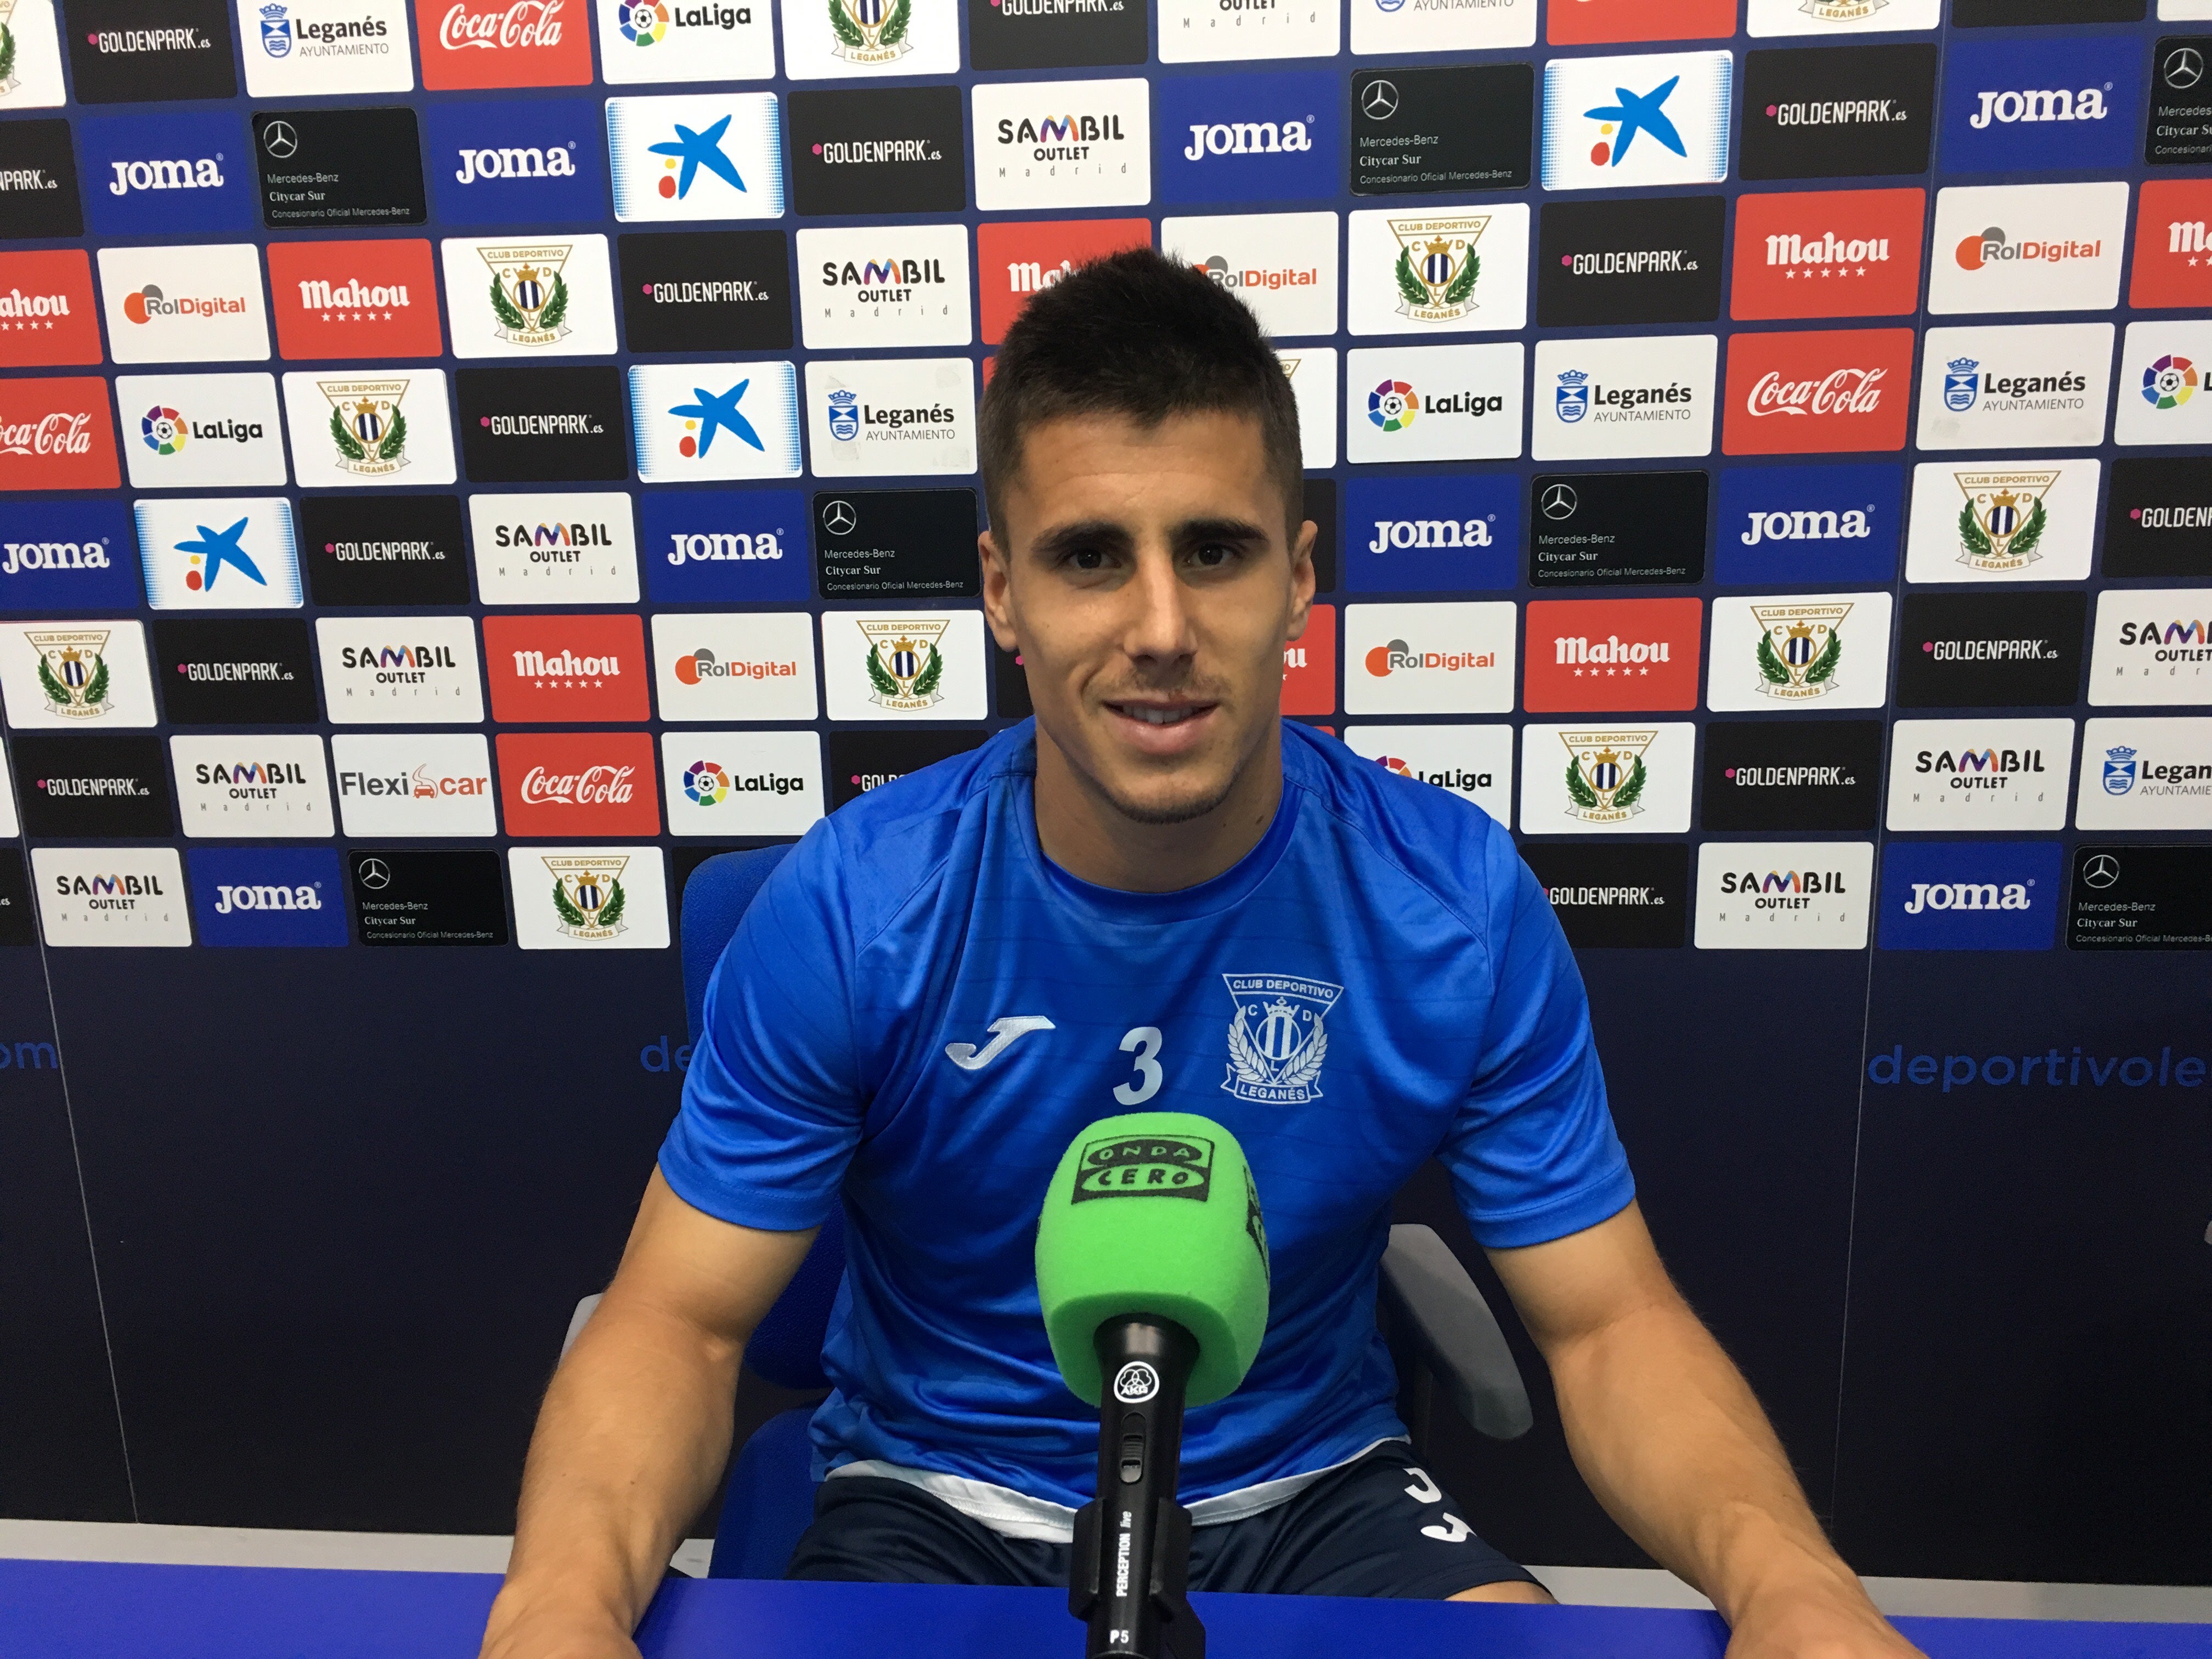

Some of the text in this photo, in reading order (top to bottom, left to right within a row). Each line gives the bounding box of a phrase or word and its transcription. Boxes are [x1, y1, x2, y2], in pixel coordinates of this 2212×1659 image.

[675, 3, 751, 30] LaLiga
[1819, 5, 1869, 18] LEGANÉS
[440, 0, 564, 49] Coca-Cola
[1184, 12, 1315, 27] Madrid
[296, 16, 387, 43] Leganés
[99, 29, 211, 53] GOLDENPARK.es
[300, 43, 388, 57] AYUNTAMIENTO
[851, 50, 895, 61] LEGANÉS
[1778, 100, 1906, 125] GOLDENPARK.es
[998, 115, 1124, 144] SAMBIL
[2157, 126, 2199, 138] Citycar
[1360, 135, 1438, 147] Mercedes-Benz
[823, 140, 941, 163] GOLDENPARK.es
[1034, 146, 1089, 161] OUTLET
[1360, 154, 1421, 168] Citycar Sur
[1000, 163, 1126, 177] Madrid
[1420, 172, 1446, 181] Oficial
[1449, 170, 1512, 179] Mercedes-Benz
[267, 173, 338, 183] Mercedes-Benz
[269, 191, 325, 203] Citycar Sur
[1426, 221, 1481, 230] DEPORTIVO
[513, 250, 563, 258] DEPORTIVO
[1765, 232, 1889, 265] Mahou
[1983, 240, 2101, 262] RolDigital
[1573, 250, 1698, 274] GOLDENPARK.es
[823, 259, 945, 286] SAMBIL
[298, 279, 410, 308] Mahou
[654, 281, 769, 303] GOLDENPARK.es
[858, 289, 911, 302] OUTLET
[146, 297, 245, 317] RolDigital
[825, 305, 947, 318] Madrid
[1414, 309, 1460, 319] LEGANÉS
[513, 333, 555, 343] LEGANÉS
[1984, 371, 2085, 398] Leganés
[1595, 383, 1691, 409] Leganés
[1747, 368, 1887, 416] Coca-Cola
[1426, 392, 1502, 416] LaLiga
[1983, 398, 2084, 410] AYUNTAMIENTO
[865, 404, 954, 428] Leganés
[1594, 409, 1690, 422] AYUNTAMIENTO
[193, 419, 263, 443] LaLiga
[491, 415, 603, 435] GOLDENPARK.es
[866, 429, 955, 441] AYUNTAMIENTO
[354, 464, 394, 475] LEGANÉS
[496, 524, 612, 547] SAMBIL
[1539, 534, 1615, 544] Mercedes-Benz
[336, 542, 445, 561] GOLDENPARK.es
[530, 551, 580, 562] OUTLET
[825, 549, 895, 558] Mercedes-Benz
[1538, 551, 1598, 563] Citycar Sur
[1976, 558, 2023, 569] LEGANÉS
[499, 566, 616, 576] Madrid
[826, 566, 881, 577] Citycar Sur
[1624, 567, 1685, 575] Mercedes-Benz
[907, 580, 963, 589] Mercedes-Benz
[1554, 635, 1670, 664] Mahou
[1934, 640, 2058, 660] GOLDENPARK.es
[342, 646, 455, 668] SAMBIL
[513, 650, 620, 676] Mahou
[1390, 652, 1494, 671] RolDigital
[188, 663, 294, 681] GOLDENPARK.es
[376, 672, 425, 683] OUTLET
[698, 662, 796, 679] RolDigital
[346, 687, 460, 696] Madrid
[1774, 688, 1820, 699] LEGANÉS
[887, 699, 927, 710] LEGANÉS
[61, 708, 101, 718] LEGANÉS
[1916, 750, 2045, 772] SAMBIL
[196, 763, 306, 784] SAMBIL
[1736, 767, 1855, 786] GOLDENPARK.es
[47, 778, 150, 795] GOLDENPARK.es
[521, 766, 635, 804] Coca-Cola
[735, 773, 803, 795] LaLiga
[1950, 777, 2007, 788] OUTLET
[229, 788, 276, 799] OUTLET
[1914, 792, 2043, 802] Madrid
[201, 803, 311, 811] Madrid
[1583, 811, 1627, 820] LEGANÉS
[57, 876, 163, 895] SAMBIL
[1721, 872, 1846, 893] SAMBIL
[1550, 887, 1664, 906] GOLDENPARK.es
[1755, 898, 1810, 909] OUTLET
[89, 899, 135, 910] OUTLET
[362, 902, 428, 910] Mercedes-Benz
[2079, 902, 2155, 911] Mercedes-Benz
[61, 913, 168, 922] Madrid
[364, 917, 397, 926] Citycar
[1719, 913, 1845, 922] Madrid
[2077, 918, 2137, 929] Citycar Sur
[1233, 980, 1333, 999] CLUB DEPORTIVO
[1248, 1005, 1312, 1021] C D
[1113, 1027, 1163, 1105] 3
[1271, 1061, 1279, 1070] L
[1240, 1084, 1305, 1099] LEGANÉS
[1100, 1147, 1189, 1159] ONDA
[1098, 1169, 1189, 1185] CERO
[1121, 1386, 1148, 1395] AKG
[1116, 1511, 1132, 1596] PERCEPTION live
